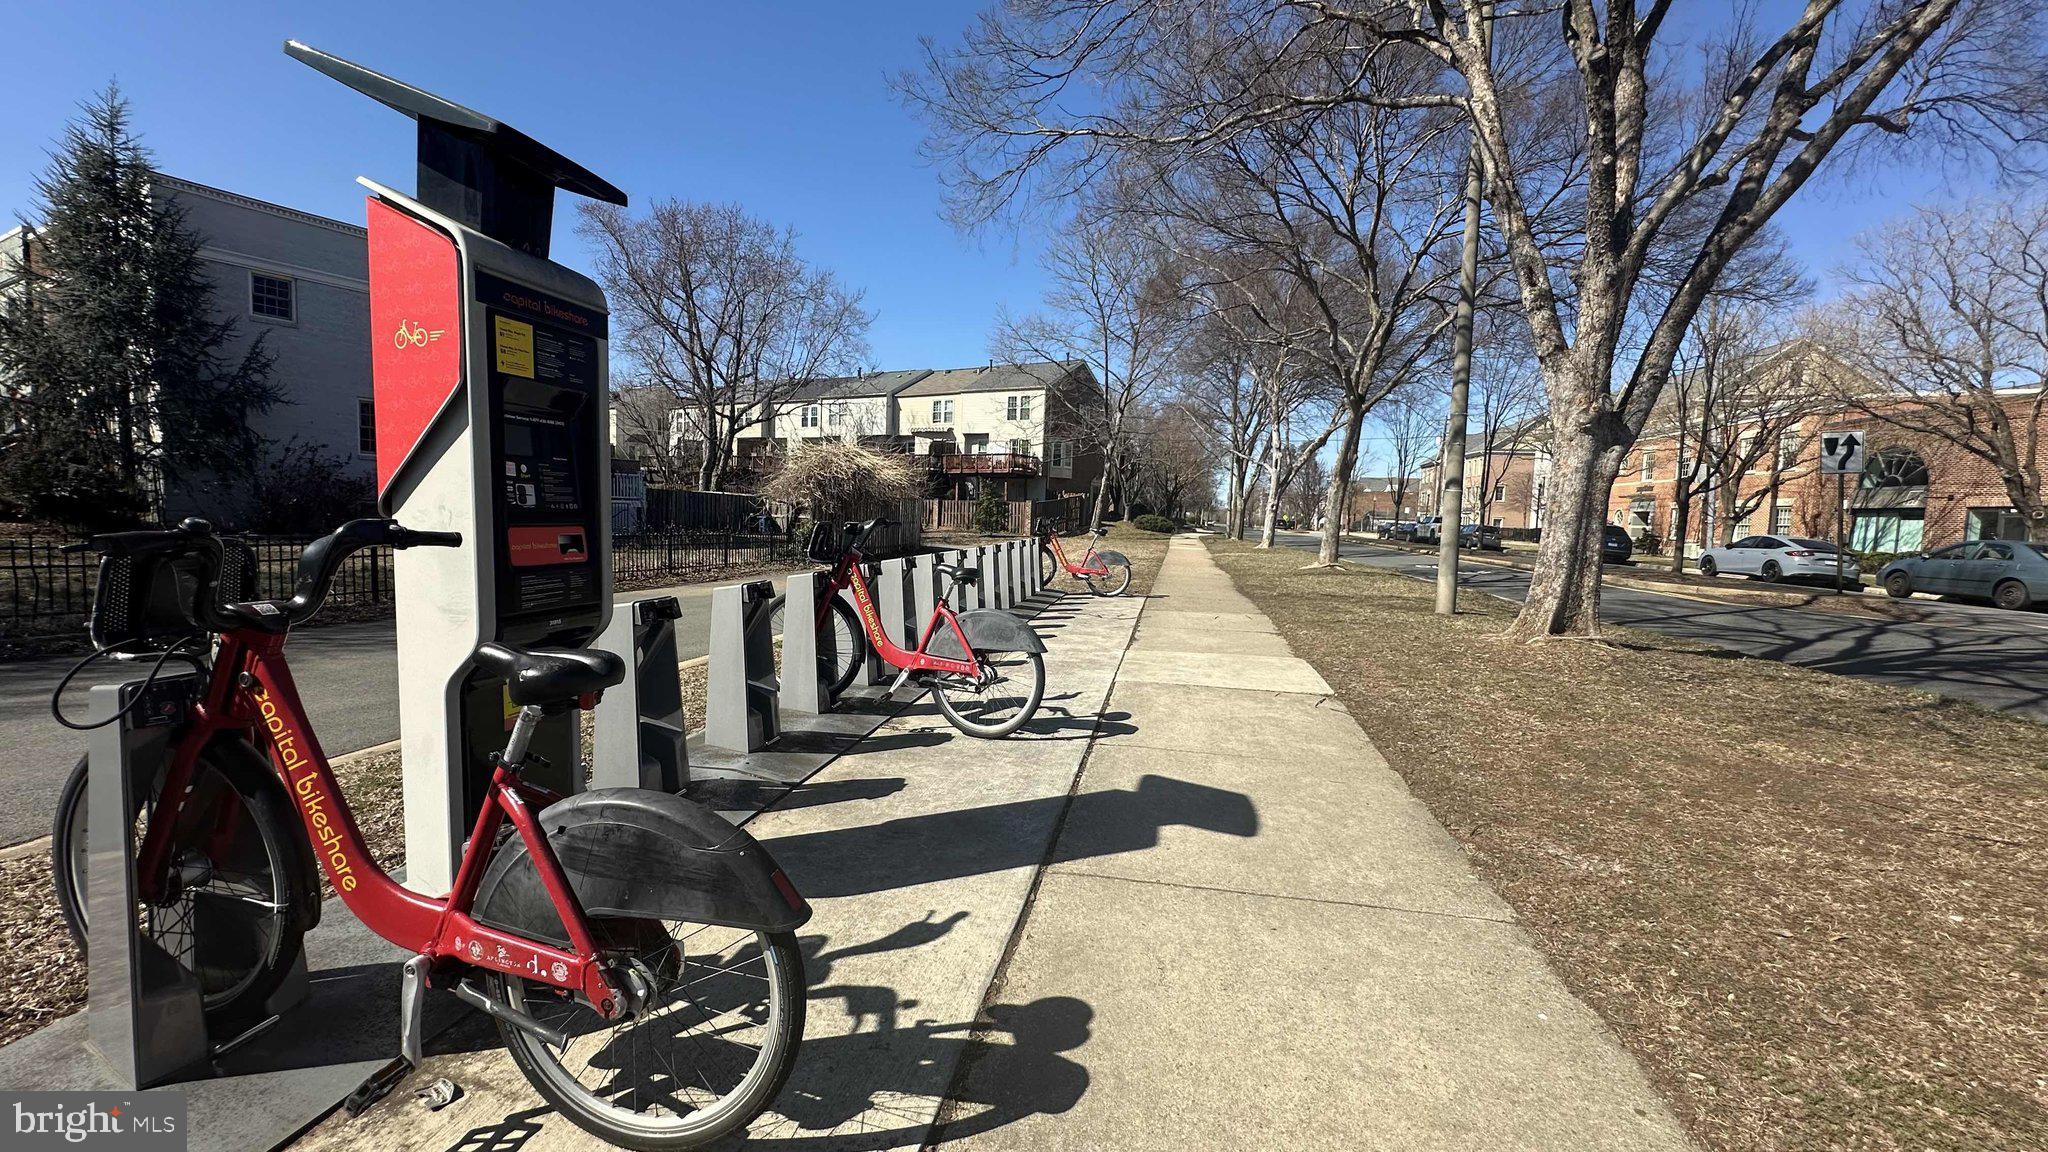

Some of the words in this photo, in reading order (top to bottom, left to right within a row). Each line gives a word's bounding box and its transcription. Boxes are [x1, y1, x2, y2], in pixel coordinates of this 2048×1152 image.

[503, 292, 541, 313] capital
[544, 300, 589, 327] bikeshare
[863, 603, 884, 647] bikeshare
[254, 688, 309, 771] capital
[296, 771, 357, 892] bikeshare
